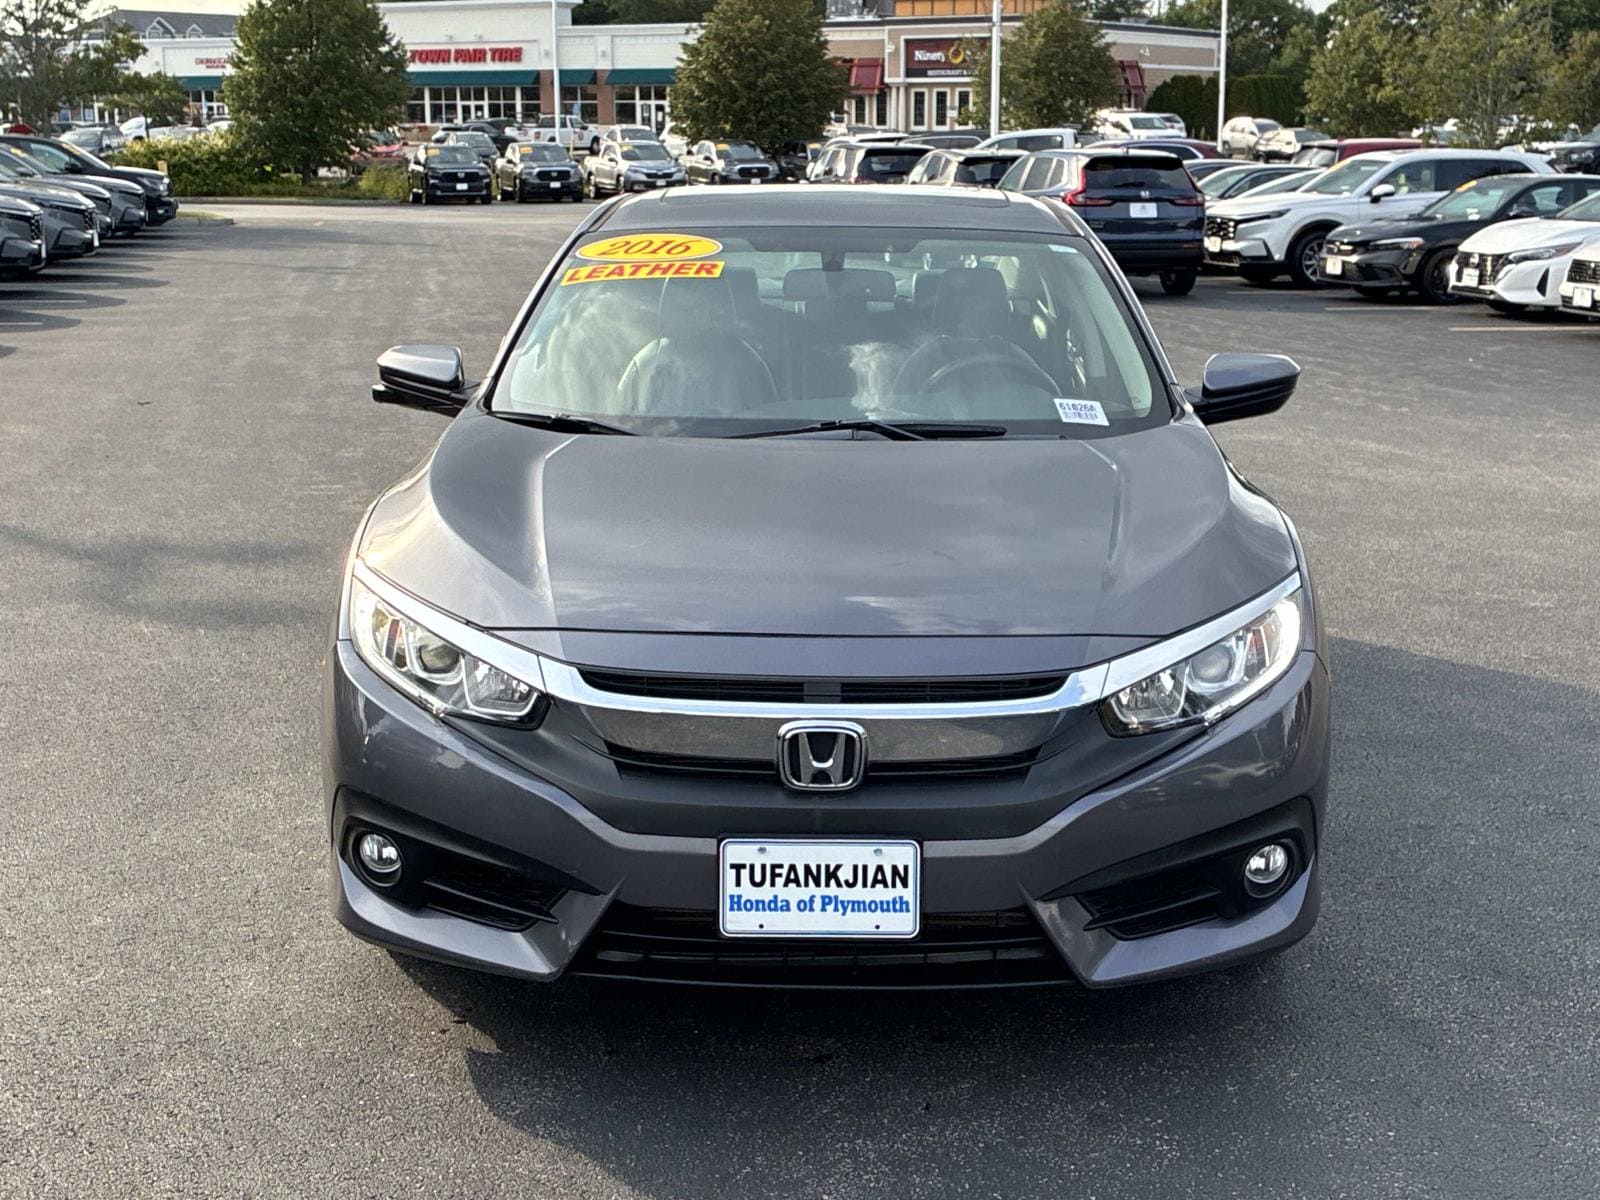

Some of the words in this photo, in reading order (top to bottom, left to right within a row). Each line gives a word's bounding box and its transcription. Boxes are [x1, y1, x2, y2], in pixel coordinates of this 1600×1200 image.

[409, 49, 451, 63] TOWN
[453, 48, 487, 63] FAIR
[488, 47, 522, 62] TIRE
[597, 239, 700, 256] 2016
[566, 262, 719, 282] LEATHER
[729, 863, 910, 889] TUFANKJIAN
[728, 894, 791, 913] Honda
[796, 895, 816, 912] of
[820, 895, 911, 916] Plymouth
